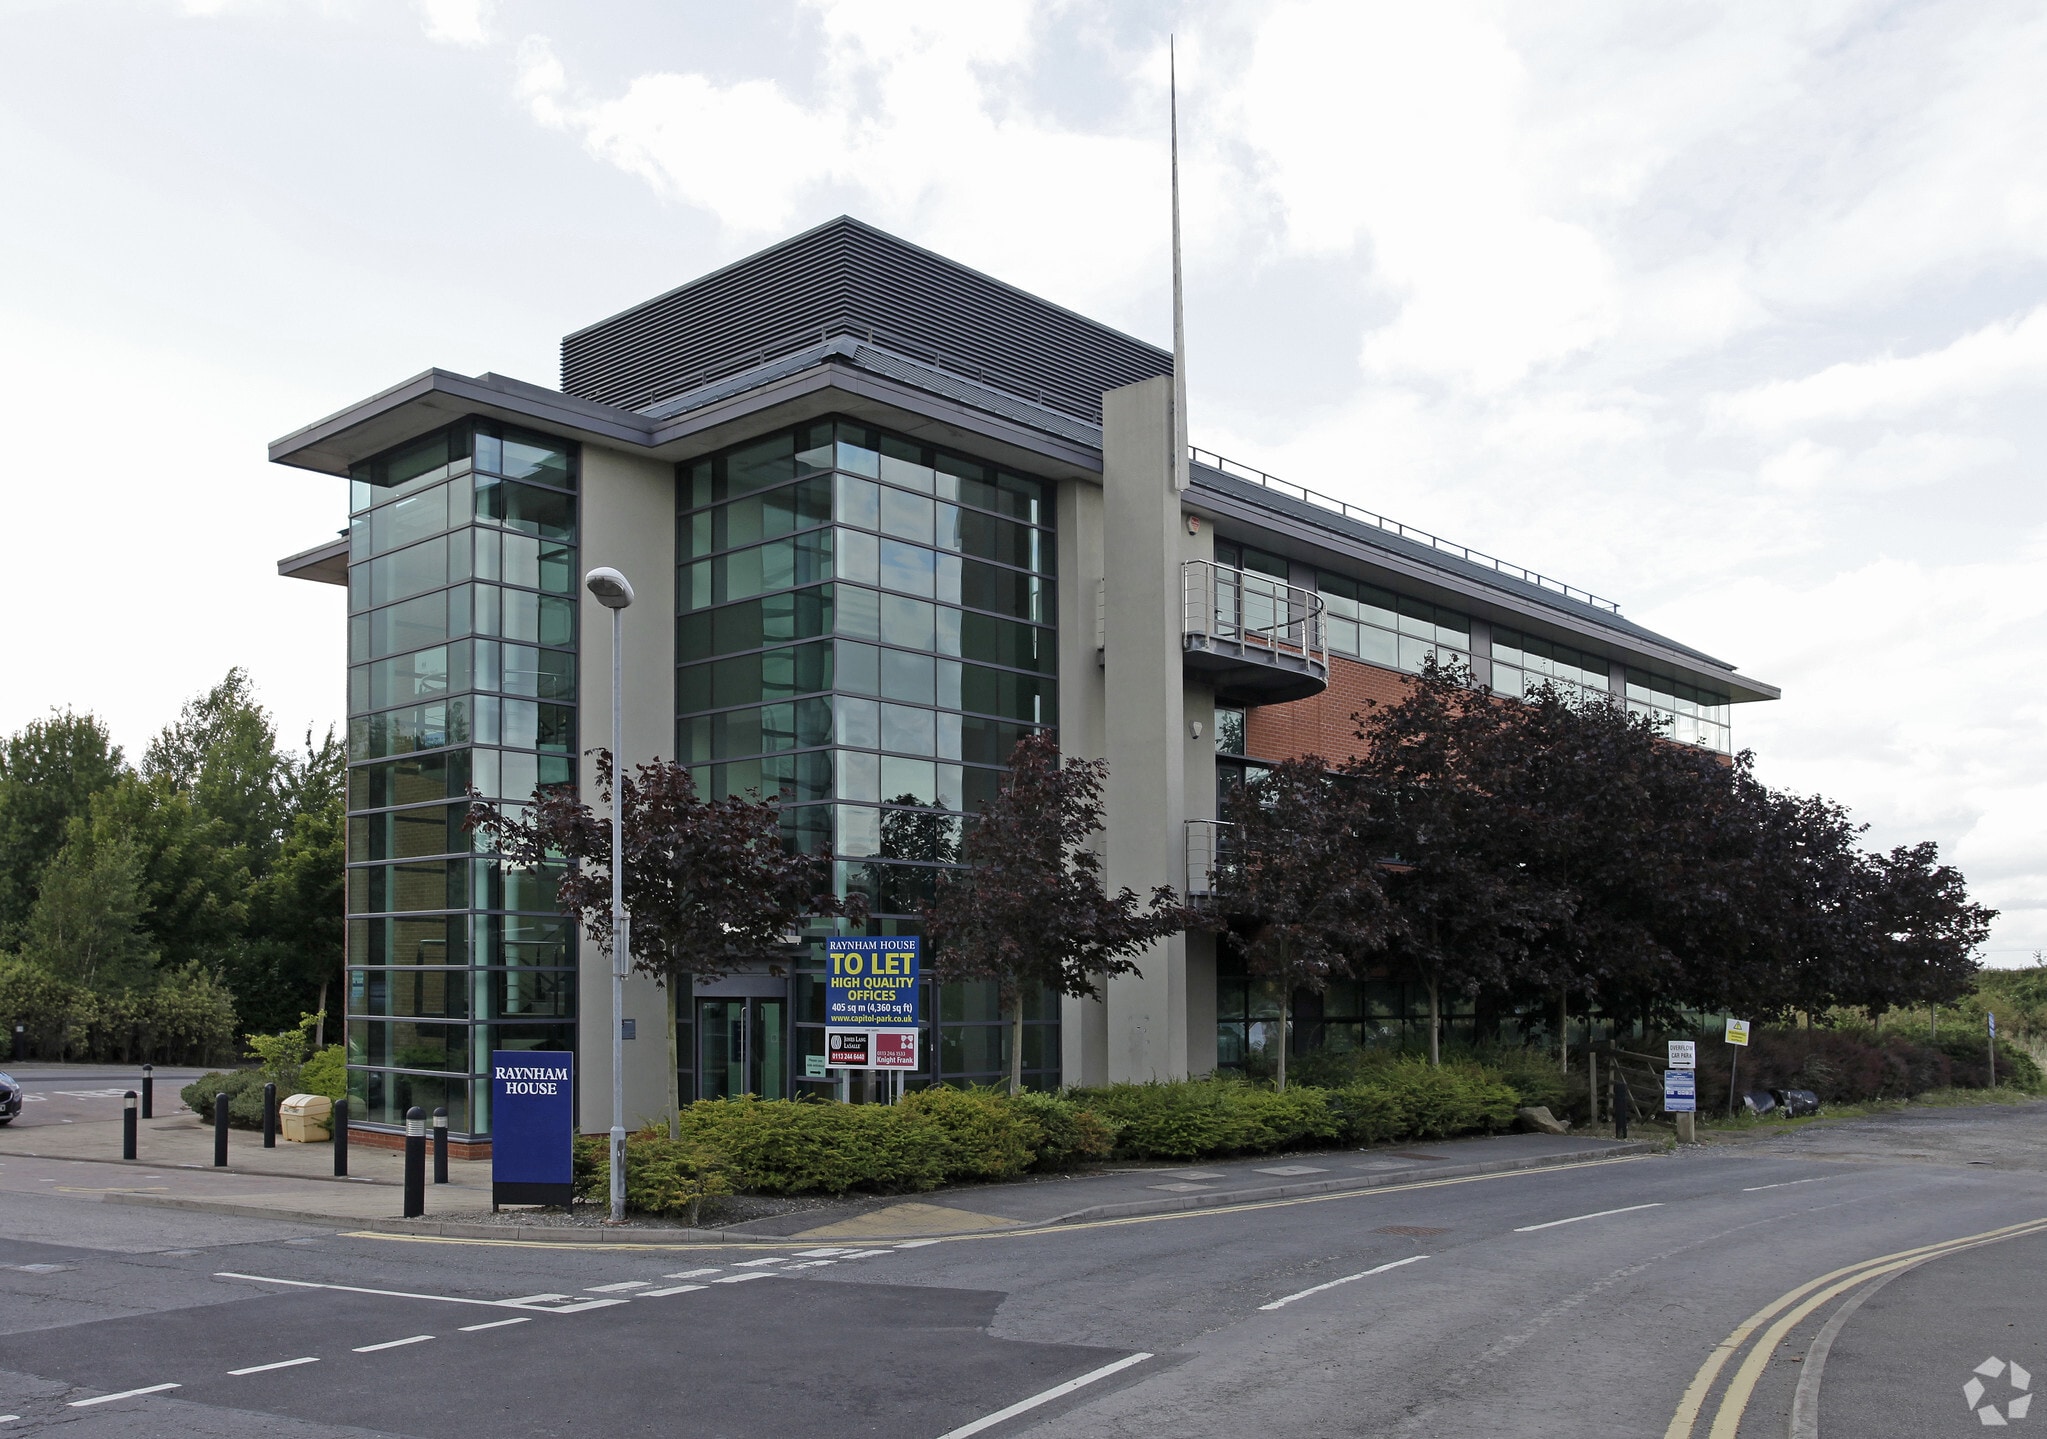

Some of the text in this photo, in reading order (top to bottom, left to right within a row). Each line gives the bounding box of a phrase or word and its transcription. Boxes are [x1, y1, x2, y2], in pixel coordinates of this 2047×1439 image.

[830, 941, 915, 950] RAYNHAM HOUSE
[830, 953, 915, 975] TO LET
[831, 977, 914, 989] HIGH QUALITY
[847, 990, 896, 1001] OFFICES
[832, 1003, 913, 1014] 405 sq m (4,360 sq ft)
[831, 1014, 912, 1023] www.capitol-park.co.uk
[877, 1056, 914, 1064] Knight Frank
[495, 1067, 568, 1080] RAYNHAM
[505, 1082, 557, 1095] HOUSE
